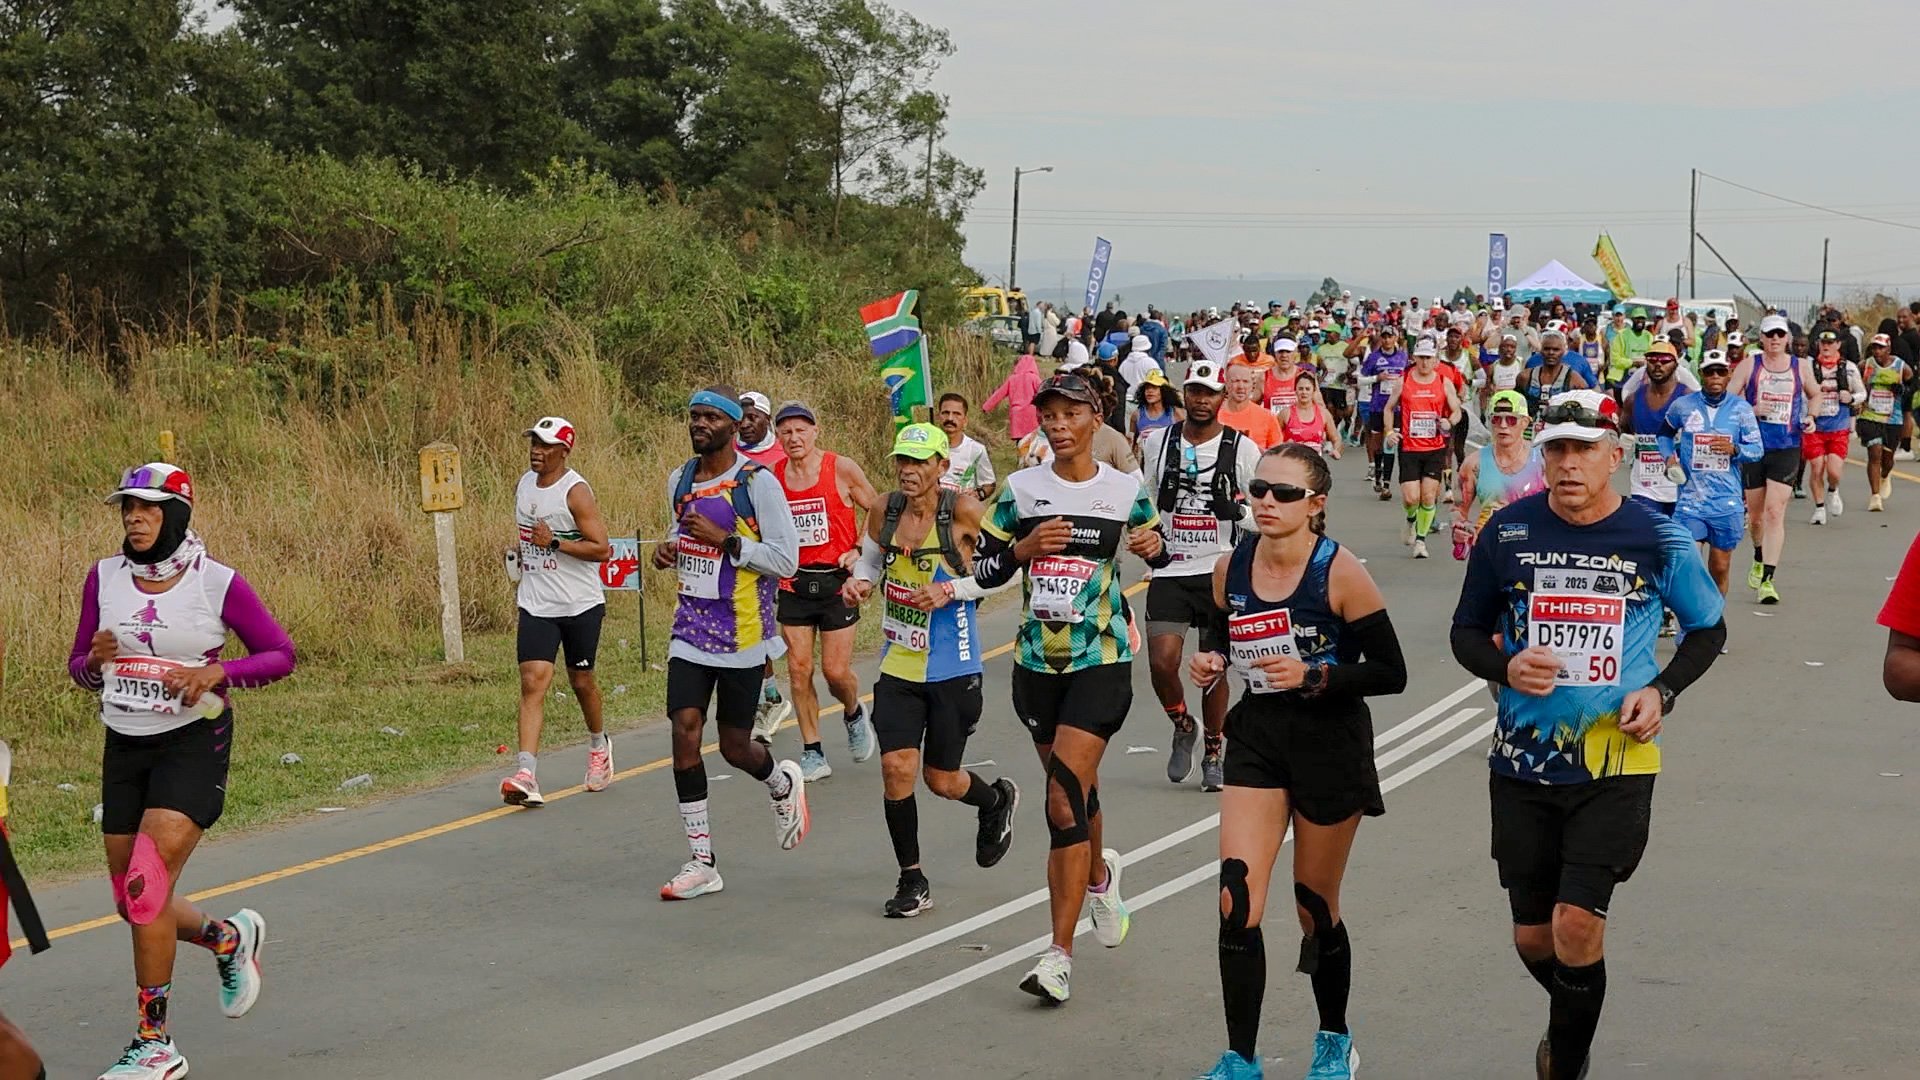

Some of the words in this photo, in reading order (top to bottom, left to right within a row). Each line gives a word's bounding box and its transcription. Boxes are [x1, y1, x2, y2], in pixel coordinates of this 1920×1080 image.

[1644, 463, 1664, 473] H397
[791, 502, 821, 511] HIRSTI
[792, 514, 824, 528] 20696
[1173, 517, 1216, 527] THIRSTI
[813, 528, 828, 543] 60
[1071, 528, 1101, 538] PHIN
[1173, 531, 1216, 543] H43444
[680, 539, 719, 555] THIRSTI
[543, 559, 558, 571] 40
[678, 554, 715, 576] M51130
[1035, 561, 1094, 576] THIRSTI
[1514, 552, 1568, 566] RUN
[1569, 553, 1638, 575] ZONE
[1565, 576, 1588, 590] 2025
[1537, 602, 1616, 616] THIRSTI
[956, 601, 972, 662] BRASIL
[1228, 617, 1286, 635] HIRSTI
[911, 630, 927, 649] 60
[1538, 623, 1615, 650] D57976
[114, 662, 173, 676] THIRST
[1588, 655, 1618, 682] 50
